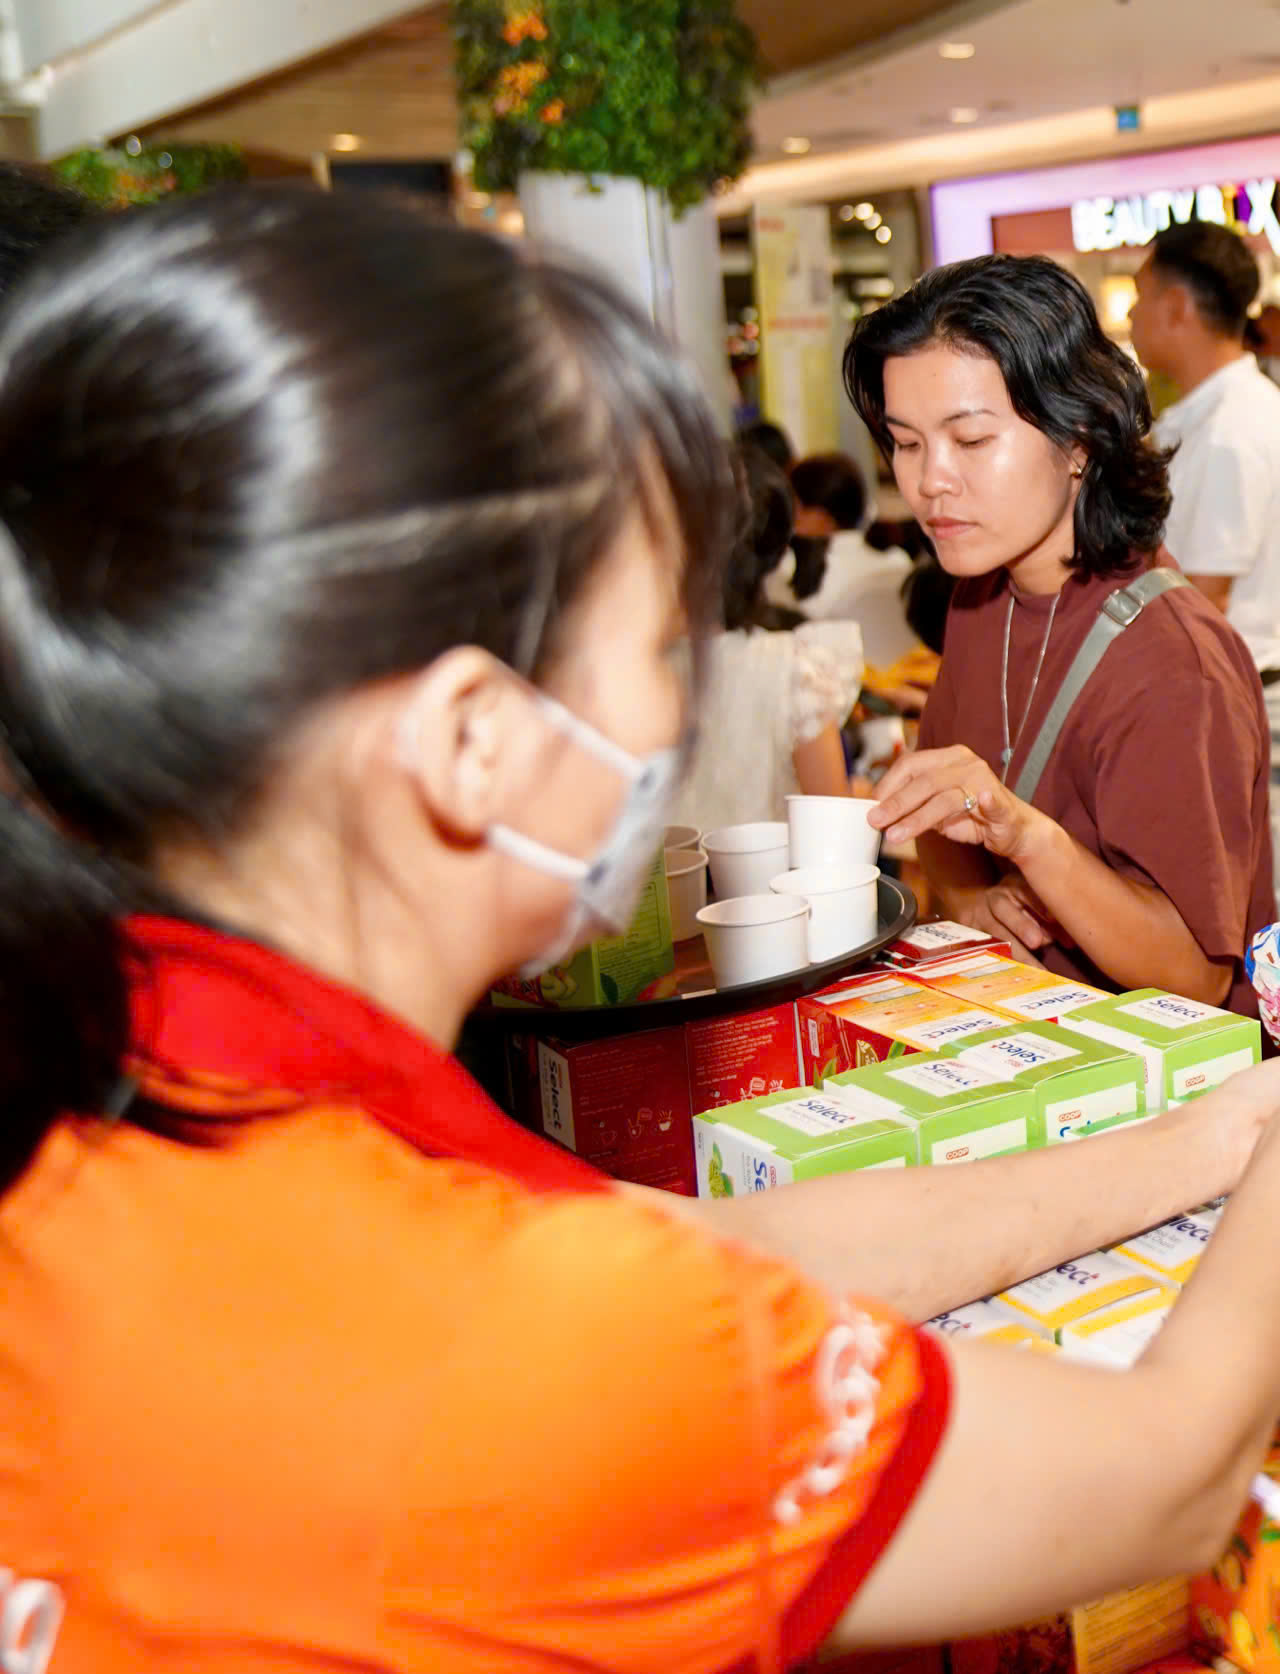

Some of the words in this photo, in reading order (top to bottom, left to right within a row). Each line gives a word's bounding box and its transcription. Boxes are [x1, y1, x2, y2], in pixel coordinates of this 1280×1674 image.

[1020, 990, 1089, 1010] Select
[1149, 999, 1205, 1019] Select
[920, 1018, 993, 1039] Select
[991, 1040, 1046, 1063] Select
[549, 1056, 563, 1131] Select
[798, 1099, 857, 1124] Select
